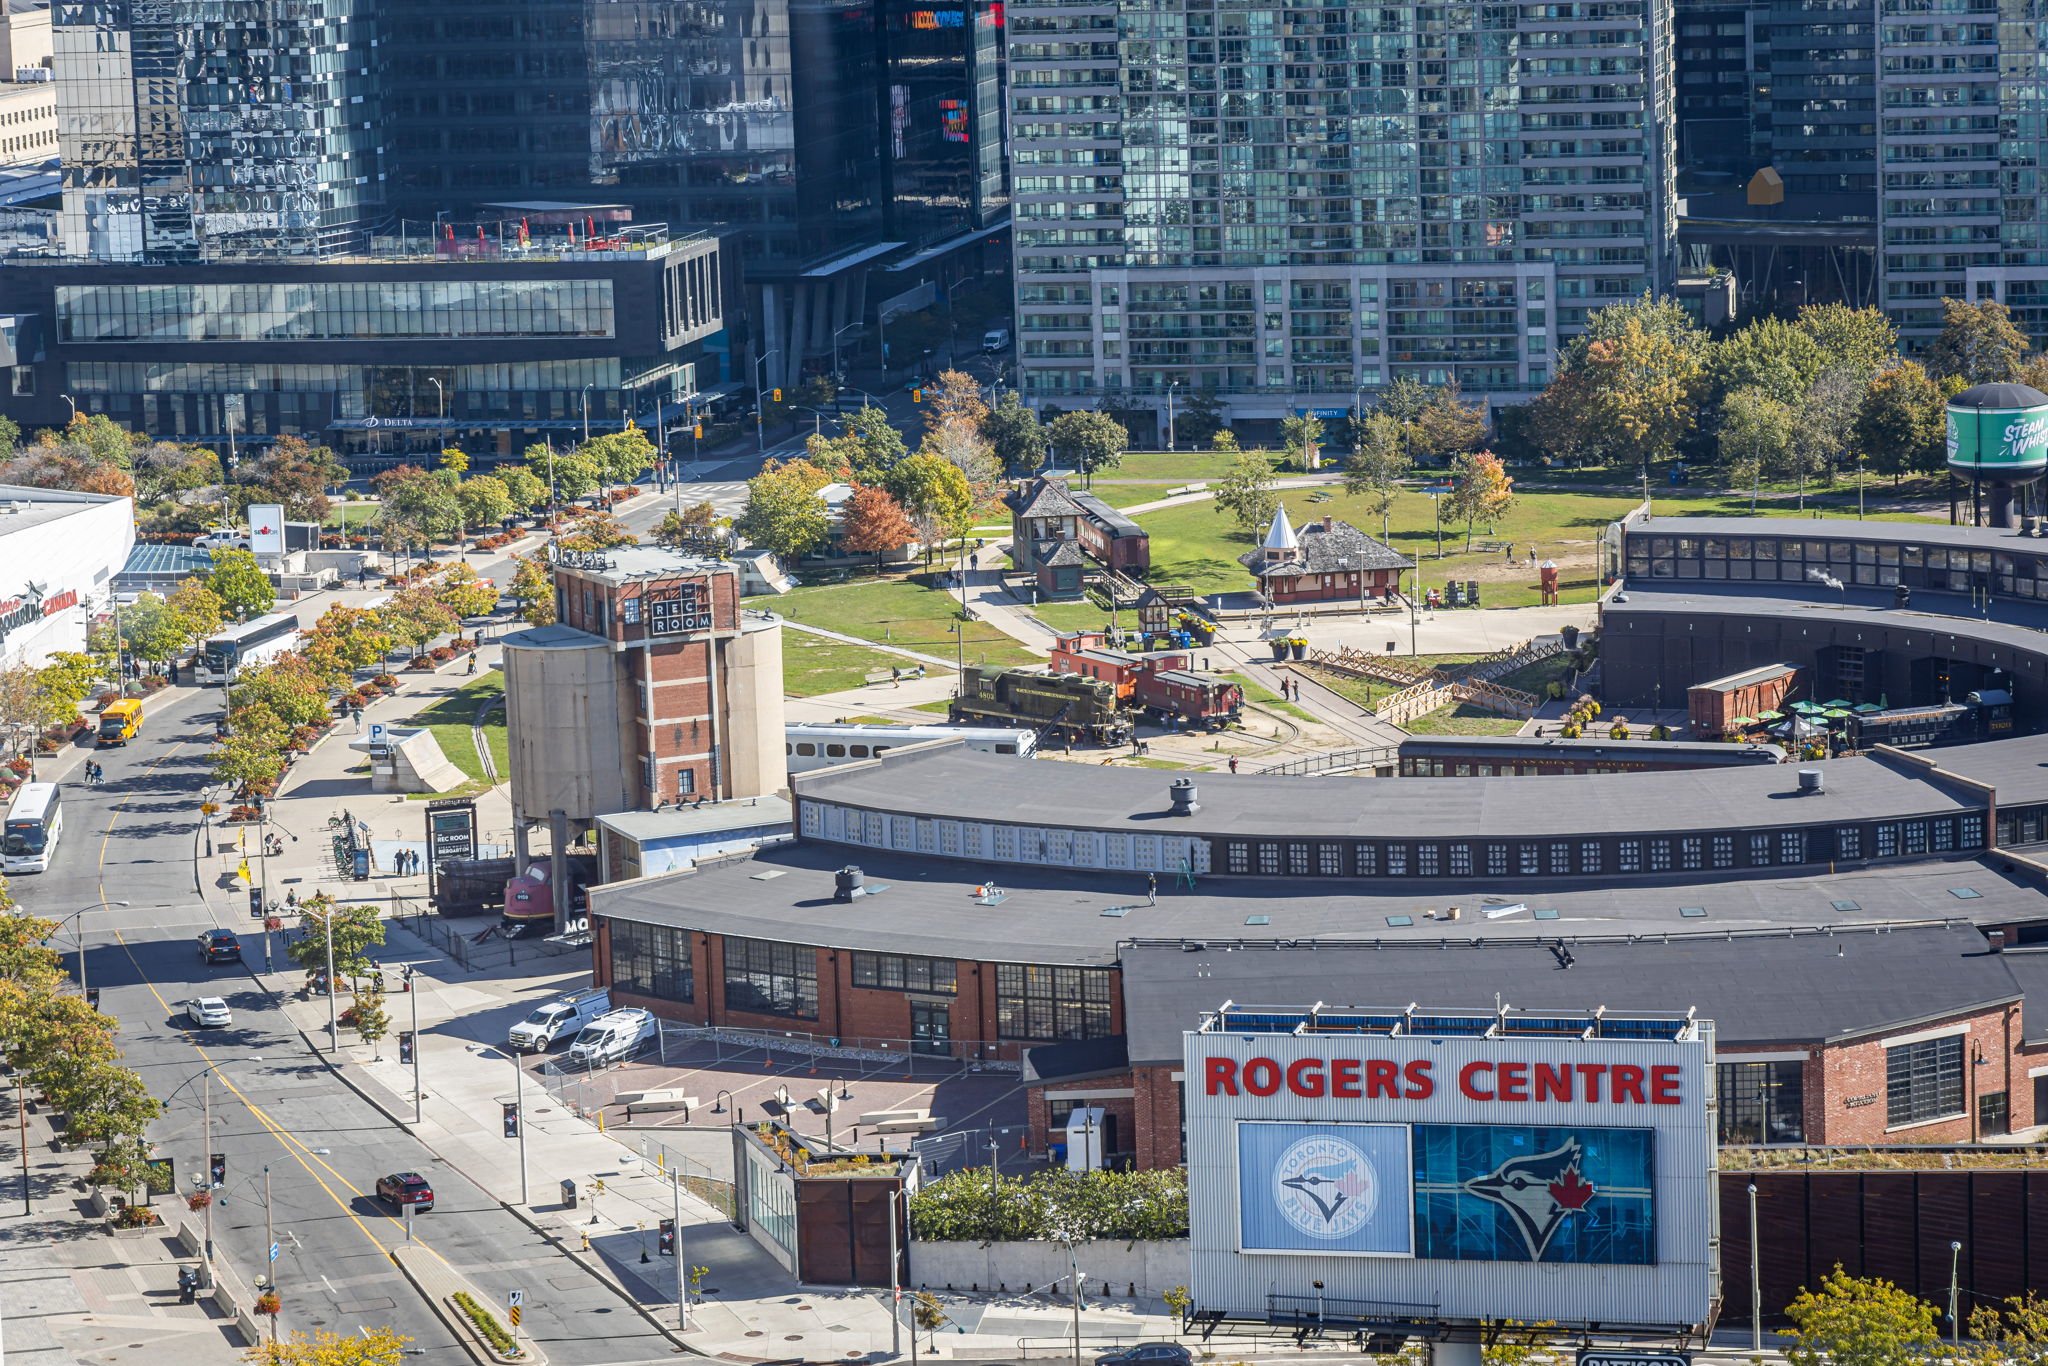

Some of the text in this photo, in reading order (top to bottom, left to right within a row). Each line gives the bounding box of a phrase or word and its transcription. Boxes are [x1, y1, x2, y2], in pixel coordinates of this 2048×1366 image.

[2003, 417, 2045, 442] STEAM
[43, 588, 79, 617] CANADA
[656, 602, 693, 615] REC
[657, 617, 709, 631] ROOM
[372, 725, 382, 738] P
[450, 834, 469, 842] ROOM
[1205, 1056, 1681, 1105] ROGERS CENTRE
[1284, 1143, 1348, 1175] TORONTO
[1284, 1197, 1367, 1232] BLUE JAYS
